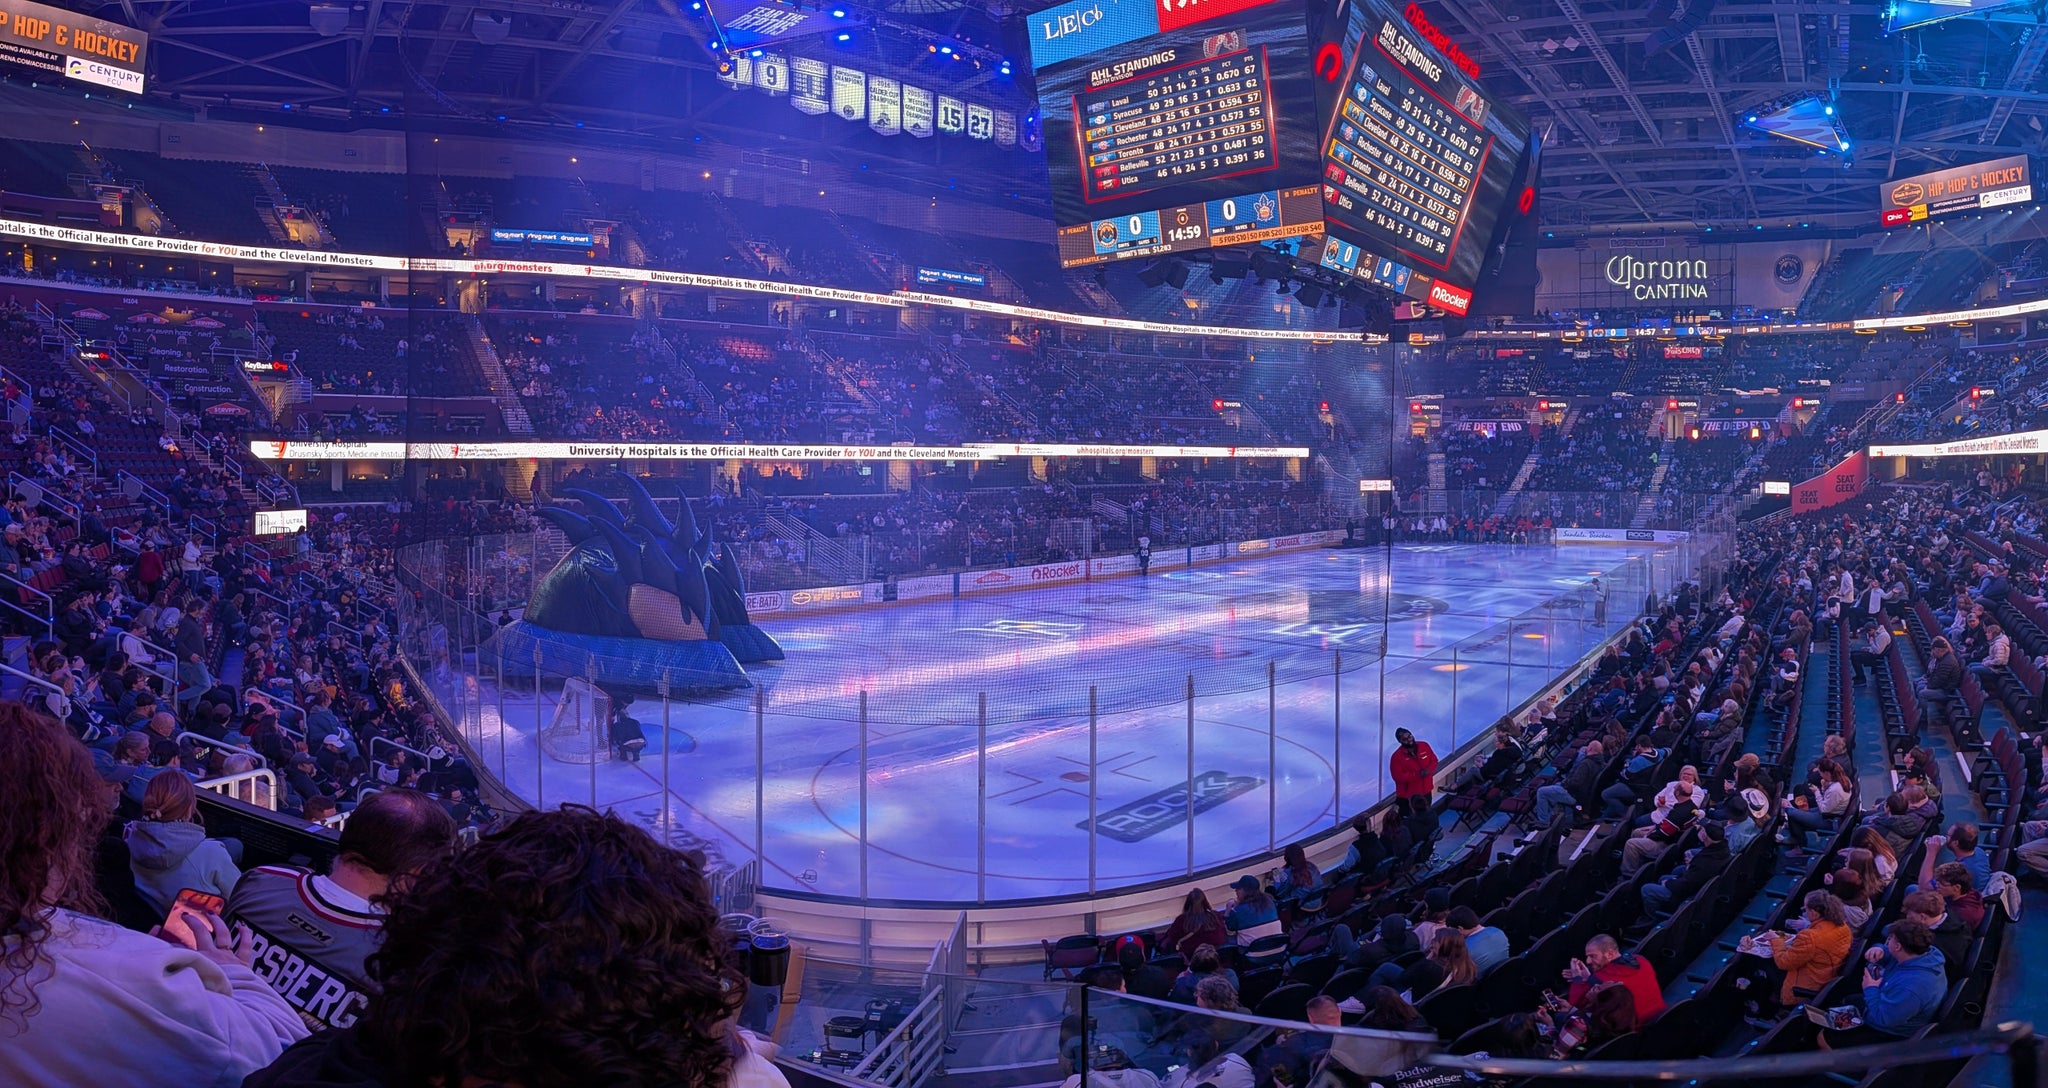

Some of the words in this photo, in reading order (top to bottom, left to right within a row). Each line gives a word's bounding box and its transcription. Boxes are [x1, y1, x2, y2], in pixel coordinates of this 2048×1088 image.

[749, 6, 783, 17] FEAR
[783, 12, 809, 21] THE
[724, 15, 798, 36] DEPTHS
[13, 15, 50, 40] HOP
[55, 25, 68, 45] &
[74, 29, 139, 63] HOCKEY
[1413, 9, 1451, 56] Rocket
[1448, 43, 1480, 80] Arena
[19, 48, 49, 59] AVAILABLE
[1381, 21, 1397, 45] AHL
[1397, 36, 1442, 83] STANDINGS
[90, 65, 140, 83] CENTURY
[766, 65, 777, 85] 9
[1091, 69, 1112, 81] AHL
[1113, 50, 1175, 74] STANDINGS
[1092, 78, 1109, 87] NORTH
[1110, 72, 1134, 81] DIVISION
[1112, 97, 1129, 107] Laval
[1148, 89, 1158, 98] 50
[1162, 85, 1172, 94] 31
[1176, 82, 1186, 91] 14
[1217, 69, 1239, 81] 0.670
[1245, 65, 1255, 74] 67
[1377, 78, 1391, 96] Laval
[1114, 107, 1142, 120] Syracuse
[1149, 102, 1160, 111] 49
[1164, 98, 1174, 107] 29
[1178, 95, 1188, 104] 16
[1218, 82, 1240, 94] 0.633
[1246, 79, 1257, 88] 62
[1370, 97, 1392, 121] Syracuse
[943, 106, 961, 128] 15
[1115, 120, 1146, 132] Cleveland
[1151, 115, 1161, 124] 48
[1166, 112, 1175, 121] 25
[1180, 108, 1189, 117] 16
[1220, 96, 1242, 108] 0.594
[1248, 93, 1258, 102] 57
[971, 115, 989, 136] 27
[1117, 133, 1148, 145] Rochester
[1153, 129, 1163, 137] 48
[1167, 125, 1177, 134] 24
[1181, 122, 1191, 131] 17
[1221, 110, 1243, 122] 0.573
[1249, 107, 1260, 116] 55
[1364, 116, 1388, 140] Cleveland
[1118, 148, 1143, 158] Toronto
[1154, 142, 1164, 150] 48
[1169, 139, 1179, 147] 24
[1183, 136, 1192, 145] 17
[1223, 125, 1245, 136] 0.573
[1251, 121, 1261, 130] 55
[1357, 136, 1381, 158] Rochester
[1120, 160, 1149, 171] Belleville
[1156, 155, 1166, 164] 52
[1170, 152, 1180, 161] 21
[1184, 150, 1194, 159] 23
[1224, 139, 1247, 150] 0.481
[1252, 135, 1263, 145] 50
[1122, 176, 1138, 185] Utica
[1157, 169, 1167, 177] 46
[1172, 166, 1182, 175] 14
[1186, 163, 1195, 172] 24
[1226, 153, 1248, 164] 0.391
[1254, 150, 1265, 159] 36
[1351, 155, 1371, 174] Toronto
[1293, 187, 1318, 196] PENALTY
[1345, 174, 1369, 195] Belleville
[1928, 182, 1944, 197] HIP
[1947, 177, 1967, 194] HOP
[1970, 176, 1978, 189] &
[1982, 166, 2023, 186] HOCKEY
[1339, 194, 1353, 210] Utica
[1994, 188, 2028, 199] CENTURY
[1223, 200, 1236, 220] 0
[1129, 216, 1141, 235] 0
[1168, 225, 1201, 241] 14:59
[29, 225, 36, 235] is
[39, 226, 54, 237] the
[58, 229, 92, 242] Official
[96, 234, 128, 245] Health
[132, 238, 154, 247] Care
[157, 239, 198, 251] Provider
[201, 243, 216, 254] for
[218, 246, 237, 256] YOU
[240, 249, 257, 258] and
[260, 250, 276, 259] the
[280, 251, 327, 262] Cleveland
[330, 255, 373, 265] Monsters
[1607, 255, 1708, 289] Corona
[651, 272, 694, 284] University
[697, 277, 733, 287] Hospitals
[736, 280, 742, 288] is
[745, 280, 757, 289] the
[760, 282, 787, 292] Official
[789, 286, 812, 294] Health
[833, 291, 862, 300] Provider
[876, 295, 889, 303] YOU
[1634, 284, 1708, 300] CANTINA
[924, 296, 952, 304] Monsters
[1440, 289, 1468, 309] Rocket
[1635, 328, 1655, 336] 14:57
[150, 347, 183, 358] Cleaning.
[164, 364, 209, 374] Restoration.
[245, 362, 272, 370] KeyBank
[184, 384, 233, 393] Construction.
[1502, 422, 1522, 432] END
[290, 450, 322, 458] Drusinsky
[325, 450, 346, 458] Sports
[348, 450, 378, 458] Medicine
[570, 446, 625, 458] University
[629, 446, 677, 458] Hospitals
[680, 446, 688, 456] is
[691, 446, 707, 456] the
[710, 447, 745, 456] Official
[749, 447, 779, 457] Health
[782, 448, 801, 457] Care
[805, 448, 841, 457] Provider
[844, 448, 856, 458] for
[859, 449, 875, 457] YOU
[877, 449, 891, 457] and
[894, 449, 907, 457] the
[909, 449, 945, 458] Cleveland
[948, 450, 980, 458] Monsters
[1835, 484, 1855, 493] GEEK
[1836, 475, 1854, 483] SEAT
[1042, 564, 1080, 580] Rocket
[288, 914, 331, 942] CCM
